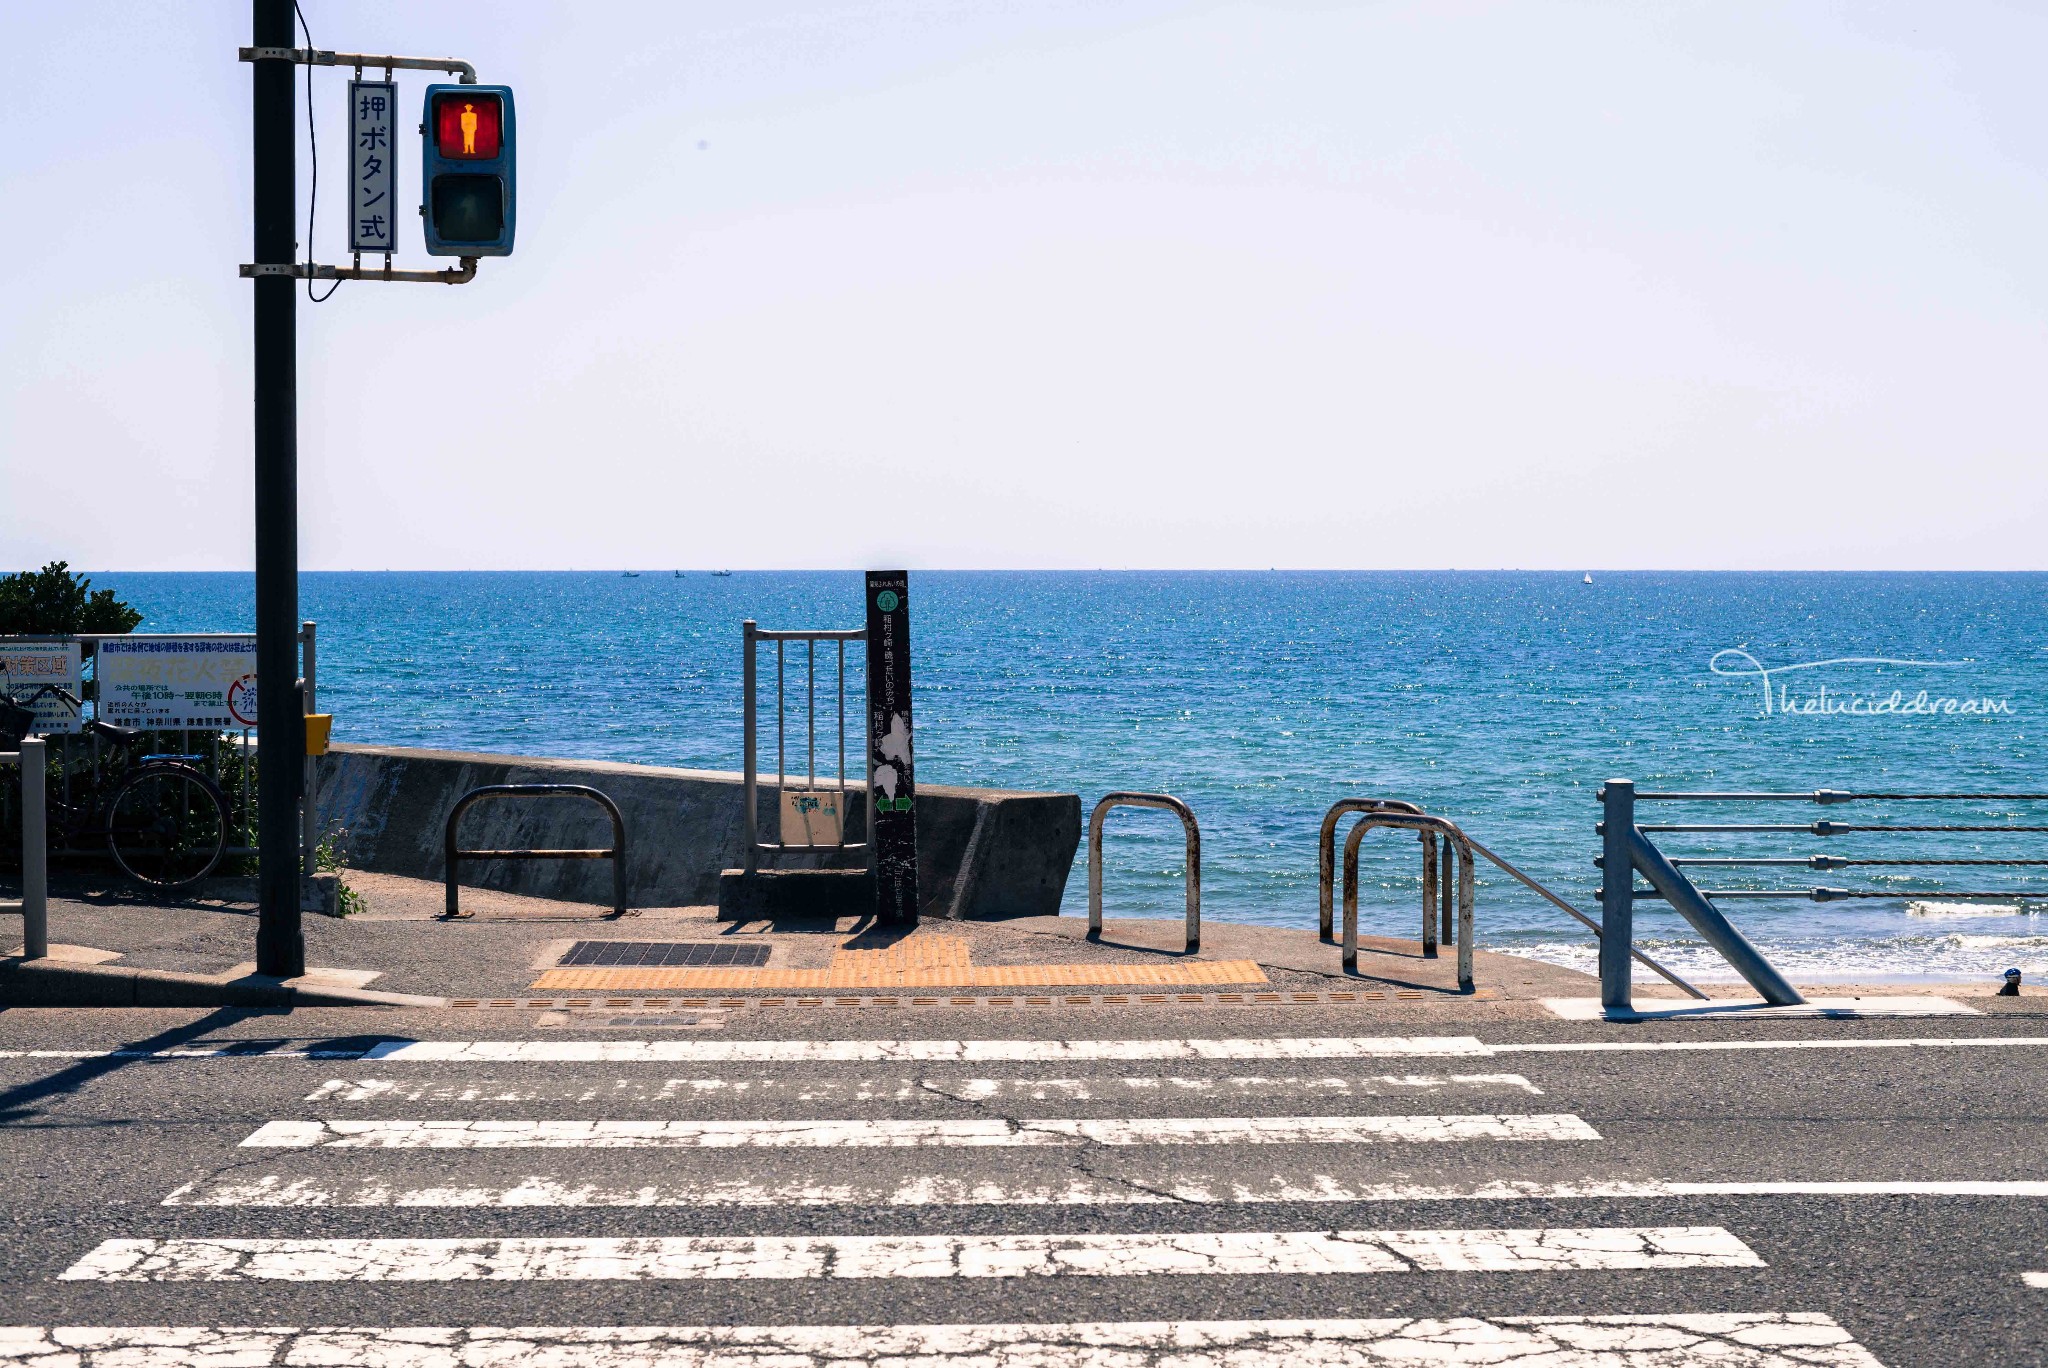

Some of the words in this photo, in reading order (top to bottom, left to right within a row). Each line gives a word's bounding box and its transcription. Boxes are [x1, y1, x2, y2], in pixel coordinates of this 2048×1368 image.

[360, 95, 387, 240] 押ボタン式
